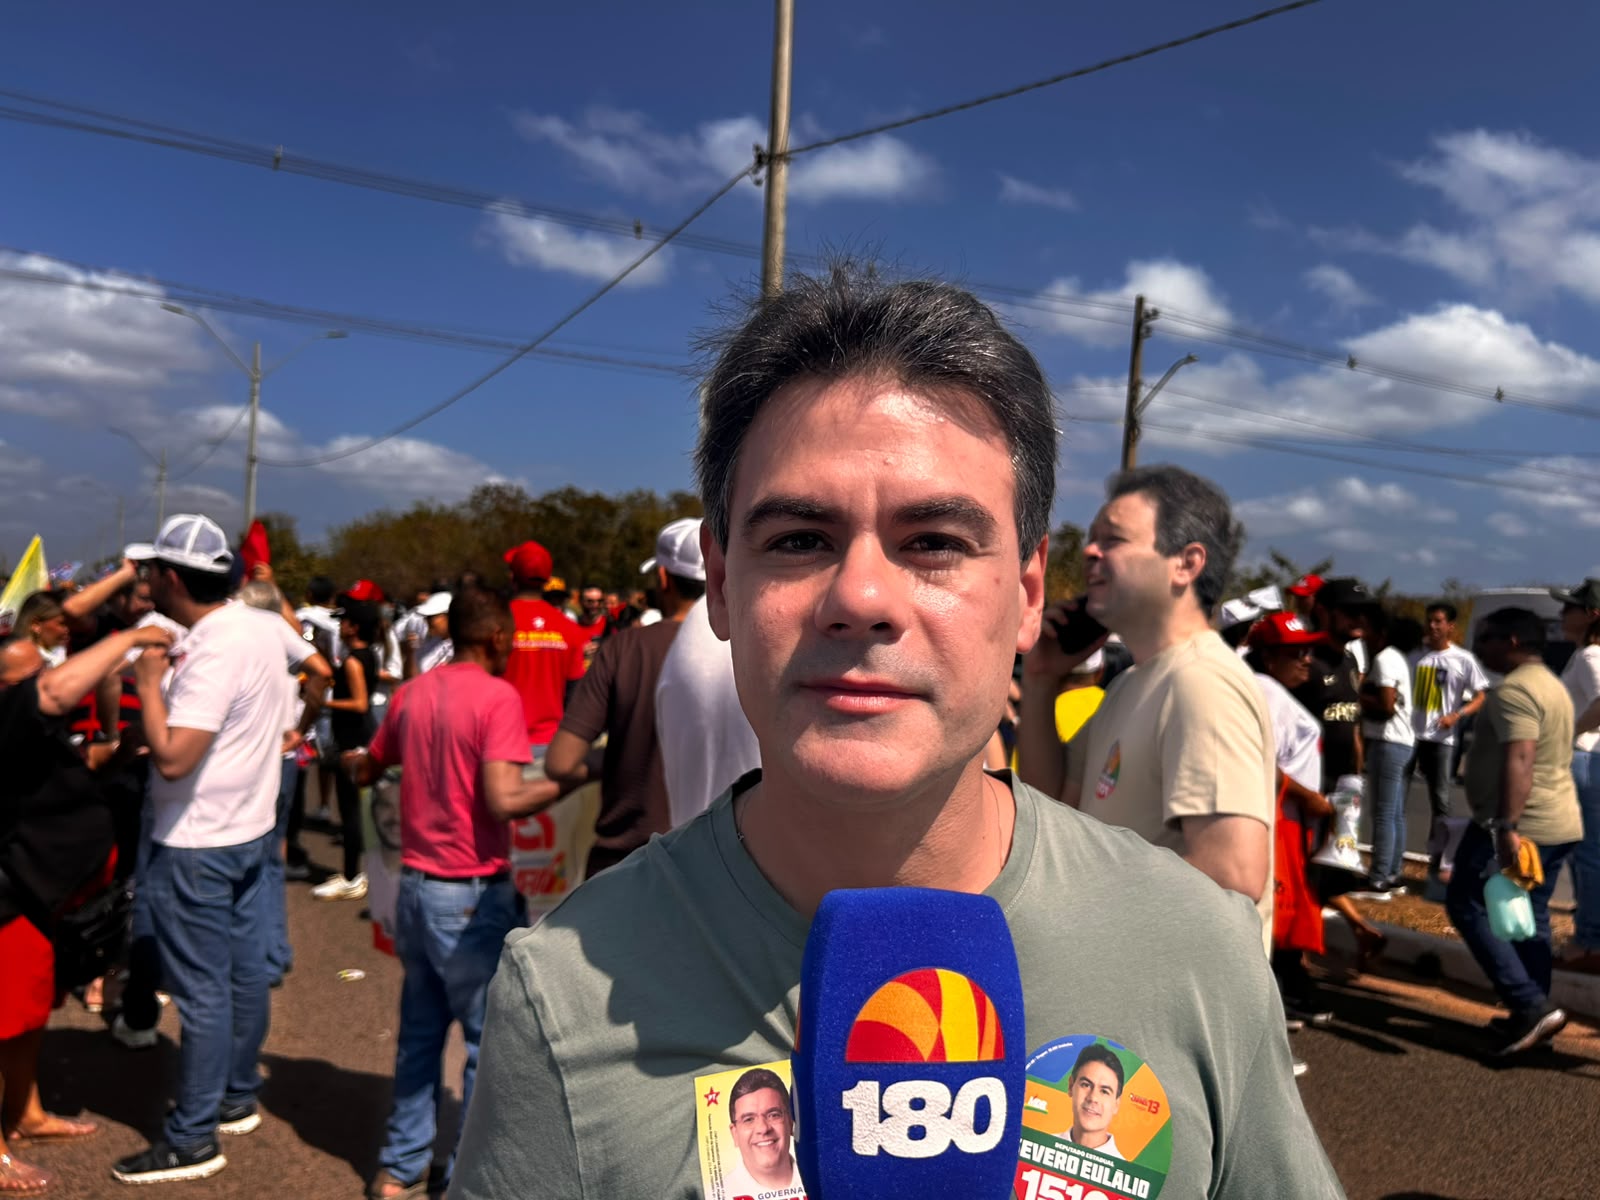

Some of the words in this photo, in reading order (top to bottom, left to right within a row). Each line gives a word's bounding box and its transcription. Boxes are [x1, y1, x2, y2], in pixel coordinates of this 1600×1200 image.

[842, 1077, 1007, 1158] 180
[1147, 1099, 1160, 1114] 13
[1019, 1138, 1080, 1175] EVERO
[1079, 1160, 1150, 1199] EULÁLIO
[1054, 1142, 1086, 1158] DEPUTADO
[1085, 1151, 1115, 1167] ESTADUAL
